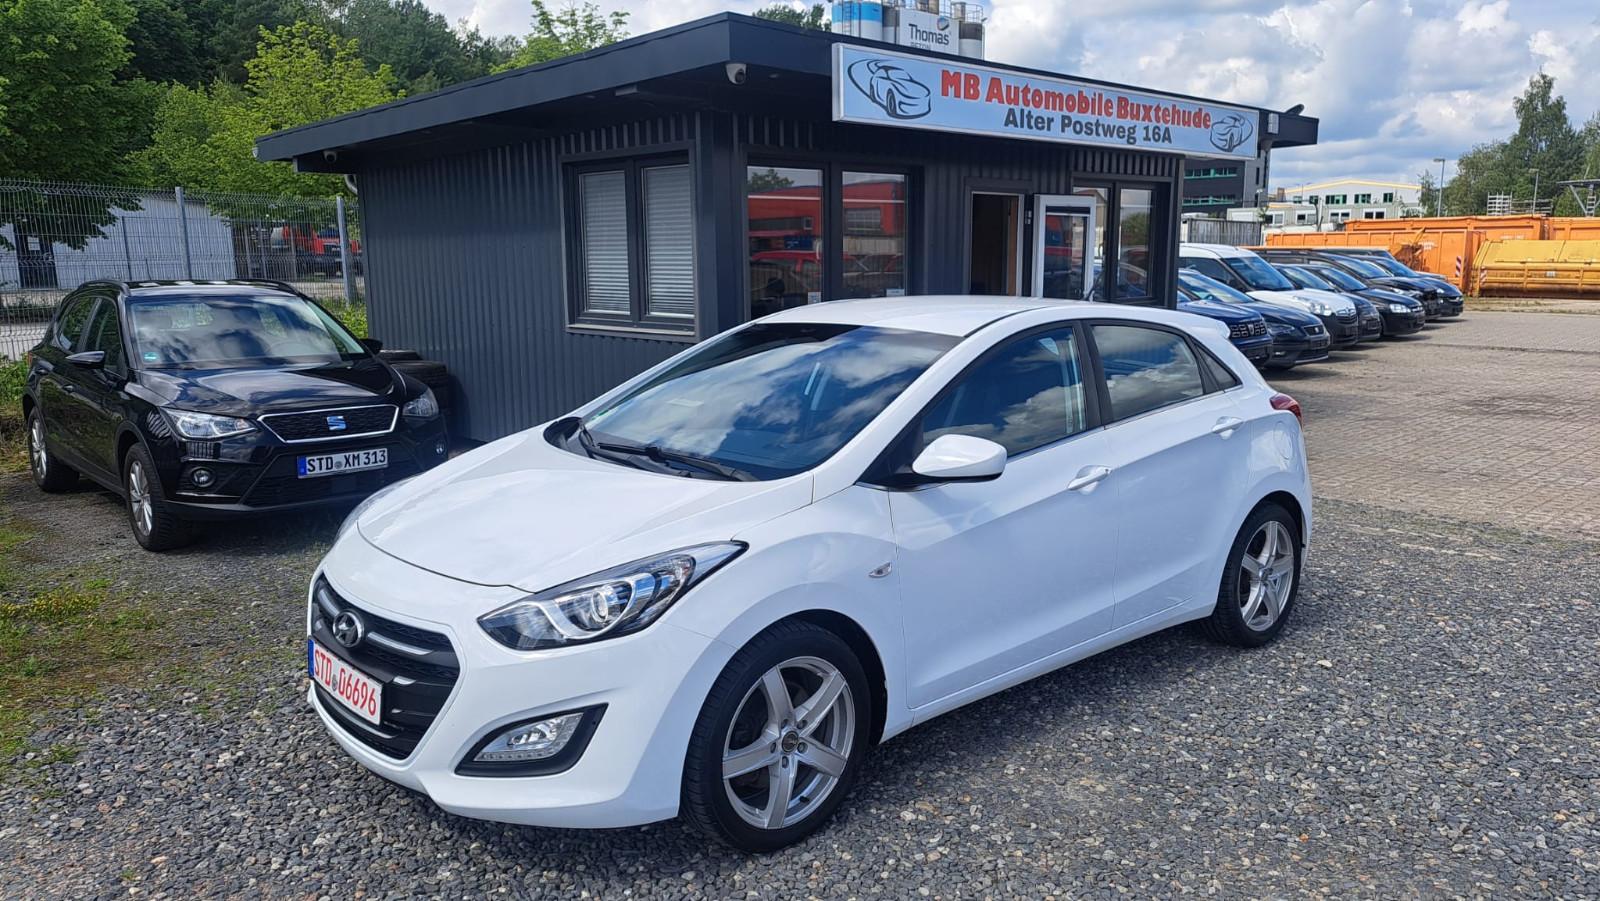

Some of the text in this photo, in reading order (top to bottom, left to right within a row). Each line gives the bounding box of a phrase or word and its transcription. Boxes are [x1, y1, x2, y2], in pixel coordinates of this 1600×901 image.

[908, 23, 950, 46] Thomas
[941, 69, 1211, 129] MB Automobile Buxtehude
[1004, 108, 1172, 145] Alter Postweg 16A
[307, 449, 386, 473] STD XM 313
[315, 649, 377, 716] STD 06696
